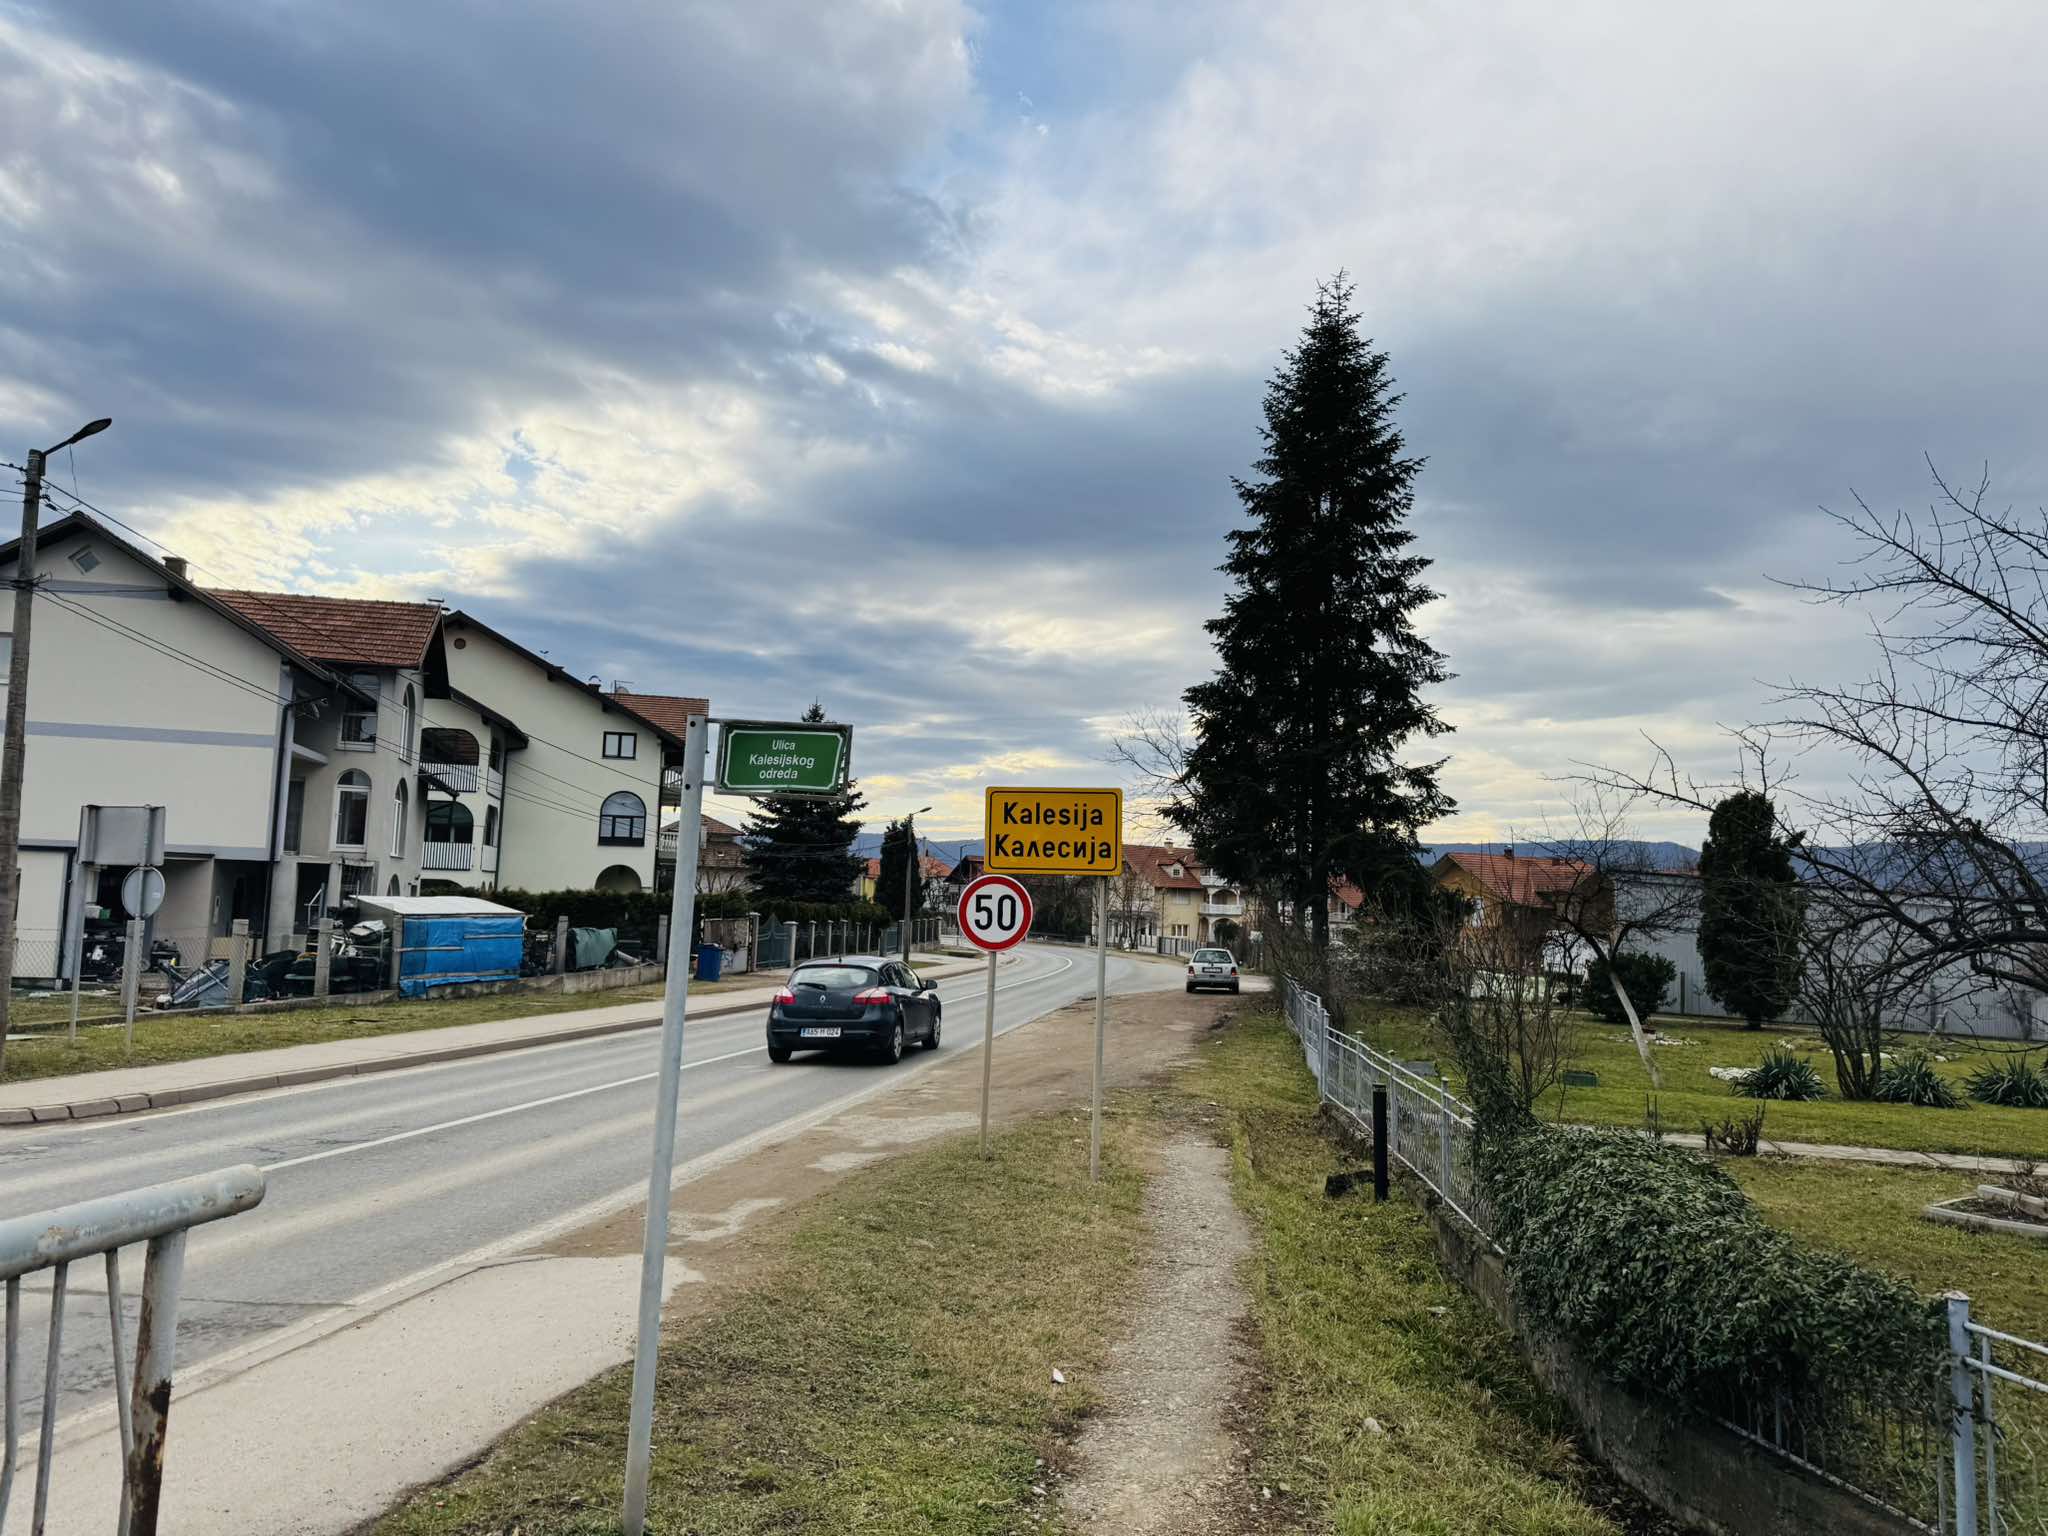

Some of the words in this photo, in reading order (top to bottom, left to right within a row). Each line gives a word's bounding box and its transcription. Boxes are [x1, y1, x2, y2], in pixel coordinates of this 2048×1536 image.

[772, 739, 796, 751] Ulica
[749, 753, 816, 769] Kalesijskog
[759, 768, 798, 779] odreda
[1003, 802, 1103, 831] Kalesija
[995, 834, 1111, 865] Калесија
[974, 894, 1016, 931] 50
